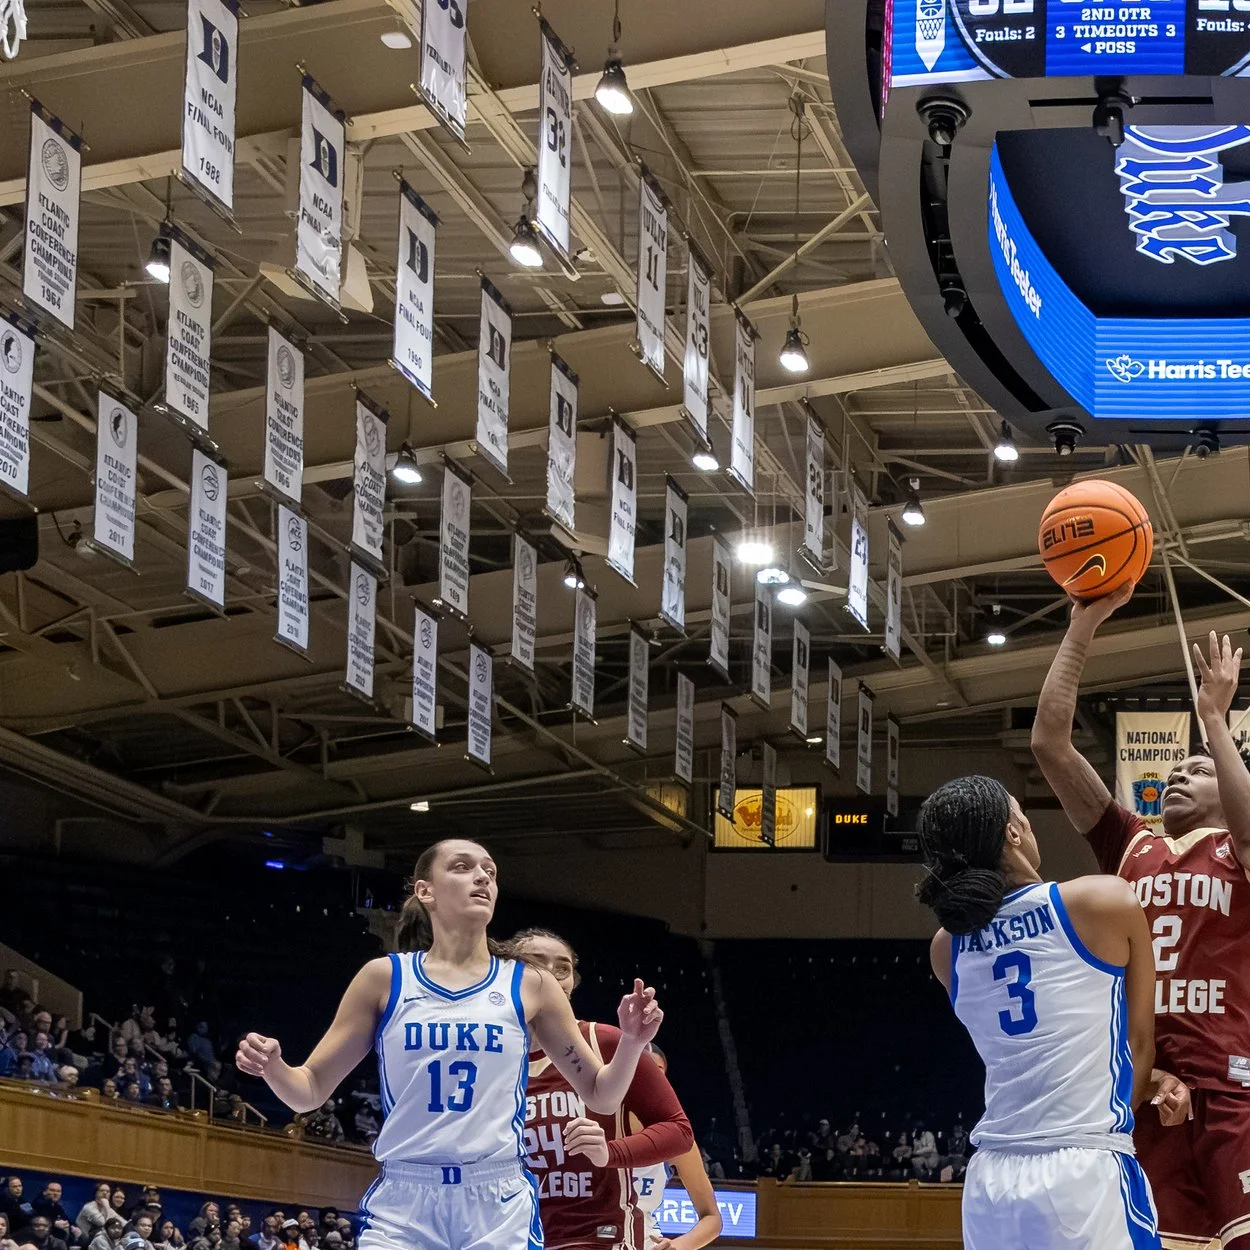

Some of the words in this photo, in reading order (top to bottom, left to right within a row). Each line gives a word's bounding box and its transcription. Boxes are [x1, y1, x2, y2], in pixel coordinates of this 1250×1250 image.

[1081, 8, 1114, 21] 2ND
[1118, 8, 1151, 21] QTR
[1197, 18, 1244, 32] Fouls:
[975, 28, 1022, 42] Fouls:
[1025, 27, 1035, 39] 2
[1055, 25, 1065, 38] 3
[1073, 25, 1158, 38] TIMEOUTS
[1166, 25, 1176, 37] 3
[1095, 42, 1136, 54] POSS
[187, 101, 212, 135] FINAL
[201, 88, 224, 120] NCAA
[200, 157, 221, 184] 1988
[38, 191, 70, 228] ATLANTIC
[41, 212, 66, 241] COAST
[29, 219, 76, 267] CONFERENCE
[30, 238, 73, 282] CHAMPIONS
[41, 285, 61, 310] 1964
[1148, 359, 1216, 379] Harris
[1042, 518, 1095, 550] ELITE
[1127, 731, 1180, 745] NATIONAL
[1120, 748, 1186, 762] CHAMPIONS
[835, 814, 868, 824] DUKE
[959, 903, 1055, 954] JACKSON
[1152, 914, 1183, 972] 2
[992, 950, 1038, 1036] 3
[1154, 979, 1226, 1014] LEGE
[404, 1022, 503, 1053] DUKE
[427, 1060, 478, 1112] 13
[525, 1091, 586, 1119] STON
[523, 1123, 565, 1168] 24
[538, 1171, 592, 1200] LEGE
